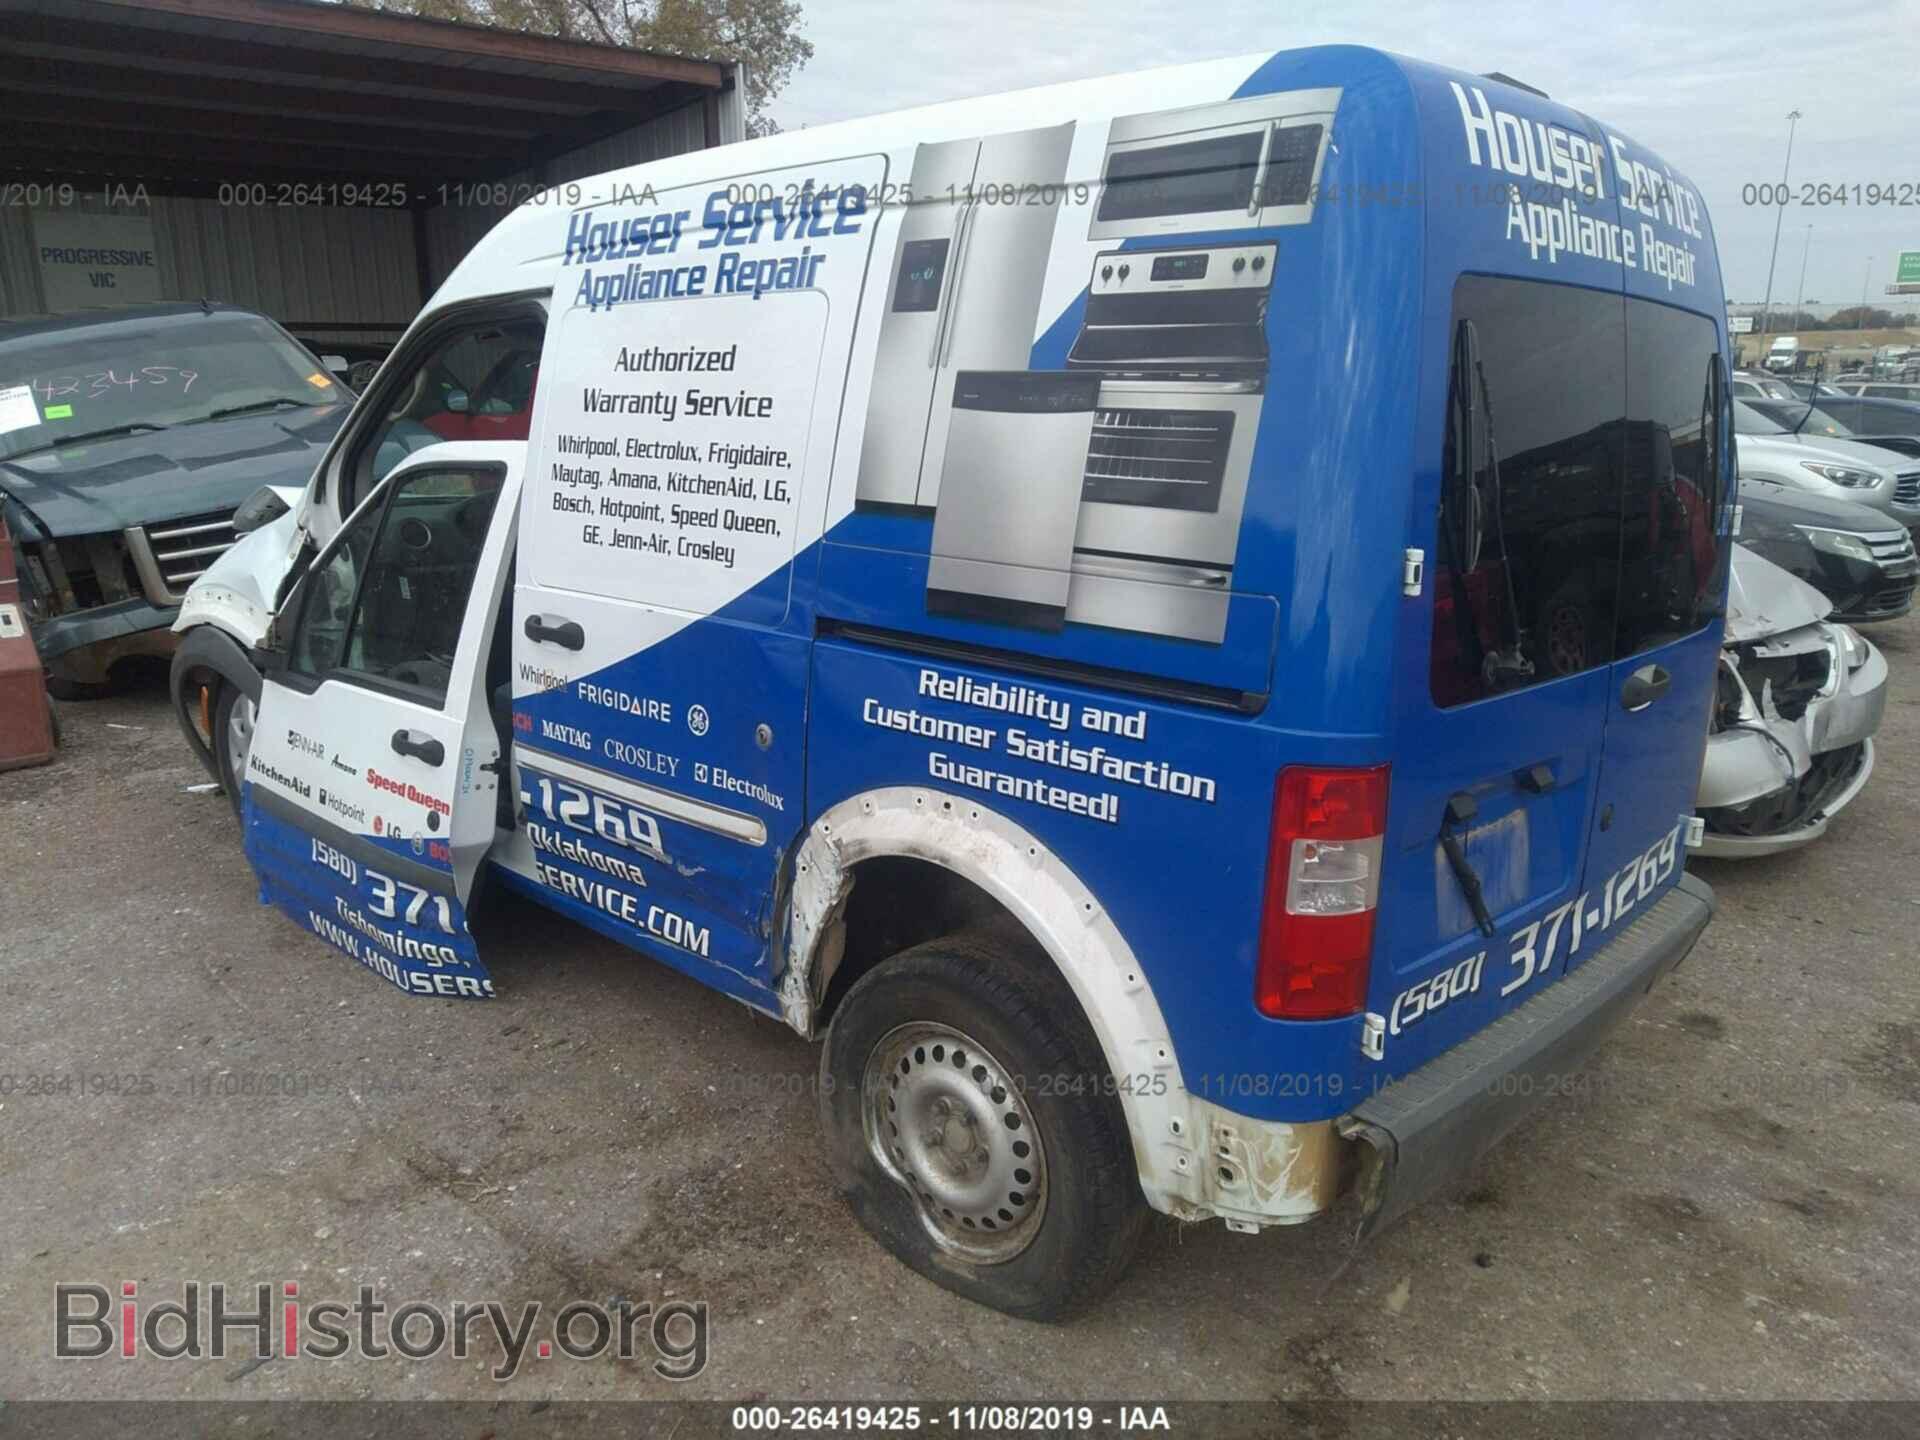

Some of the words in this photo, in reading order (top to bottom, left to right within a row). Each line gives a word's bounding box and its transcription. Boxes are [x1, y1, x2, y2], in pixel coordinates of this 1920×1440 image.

[1449, 80, 1605, 200] Houser
[1608, 135, 1702, 240] Service
[563, 211, 690, 265] Houser
[698, 178, 867, 250] Service
[1506, 185, 1636, 268] Appliance
[1640, 222, 1696, 292] Repair
[41, 247, 154, 268] PROGRESSIVE
[575, 263, 707, 312] Appliance
[714, 246, 826, 300] Repair
[614, 344, 738, 372] Authorized
[583, 388, 678, 422] Warranty
[684, 389, 773, 418] Service
[557, 434, 621, 459] Whirlpool,
[625, 438, 702, 463] Electrolux,
[708, 442, 792, 469] Frigidaire,
[551, 463, 603, 489] Maytag,
[608, 467, 661, 492] Amana,
[666, 471, 757, 501] KitchenAid,
[764, 480, 791, 503] LG,
[553, 492, 595, 515] Bosch,
[600, 496, 664, 523] Hotpoint,
[670, 504, 718, 529] Speed
[723, 509, 781, 537] Queen,
[677, 536, 735, 568] Crosley
[519, 662, 568, 693] Whirlpool
[578, 682, 671, 723] FRIGIDAIRE
[919, 669, 1071, 731] Reliability
[1081, 705, 1146, 739] and
[542, 719, 592, 751] MAYTAG
[863, 698, 996, 749] Customer
[1006, 728, 1216, 802] Satisfaction
[250, 754, 311, 798] KitchenAid
[604, 738, 680, 778] CROSLEY
[328, 795, 366, 824] Hotpoint
[366, 768, 406, 796] Speed
[407, 785, 450, 816] Queen
[712, 768, 785, 812] Electrolux
[929, 752, 1119, 823] Guaranteed!
[311, 838, 358, 885] (580)
[526, 822, 648, 888] Oklahoma
[1390, 952, 1486, 1036] (580)
